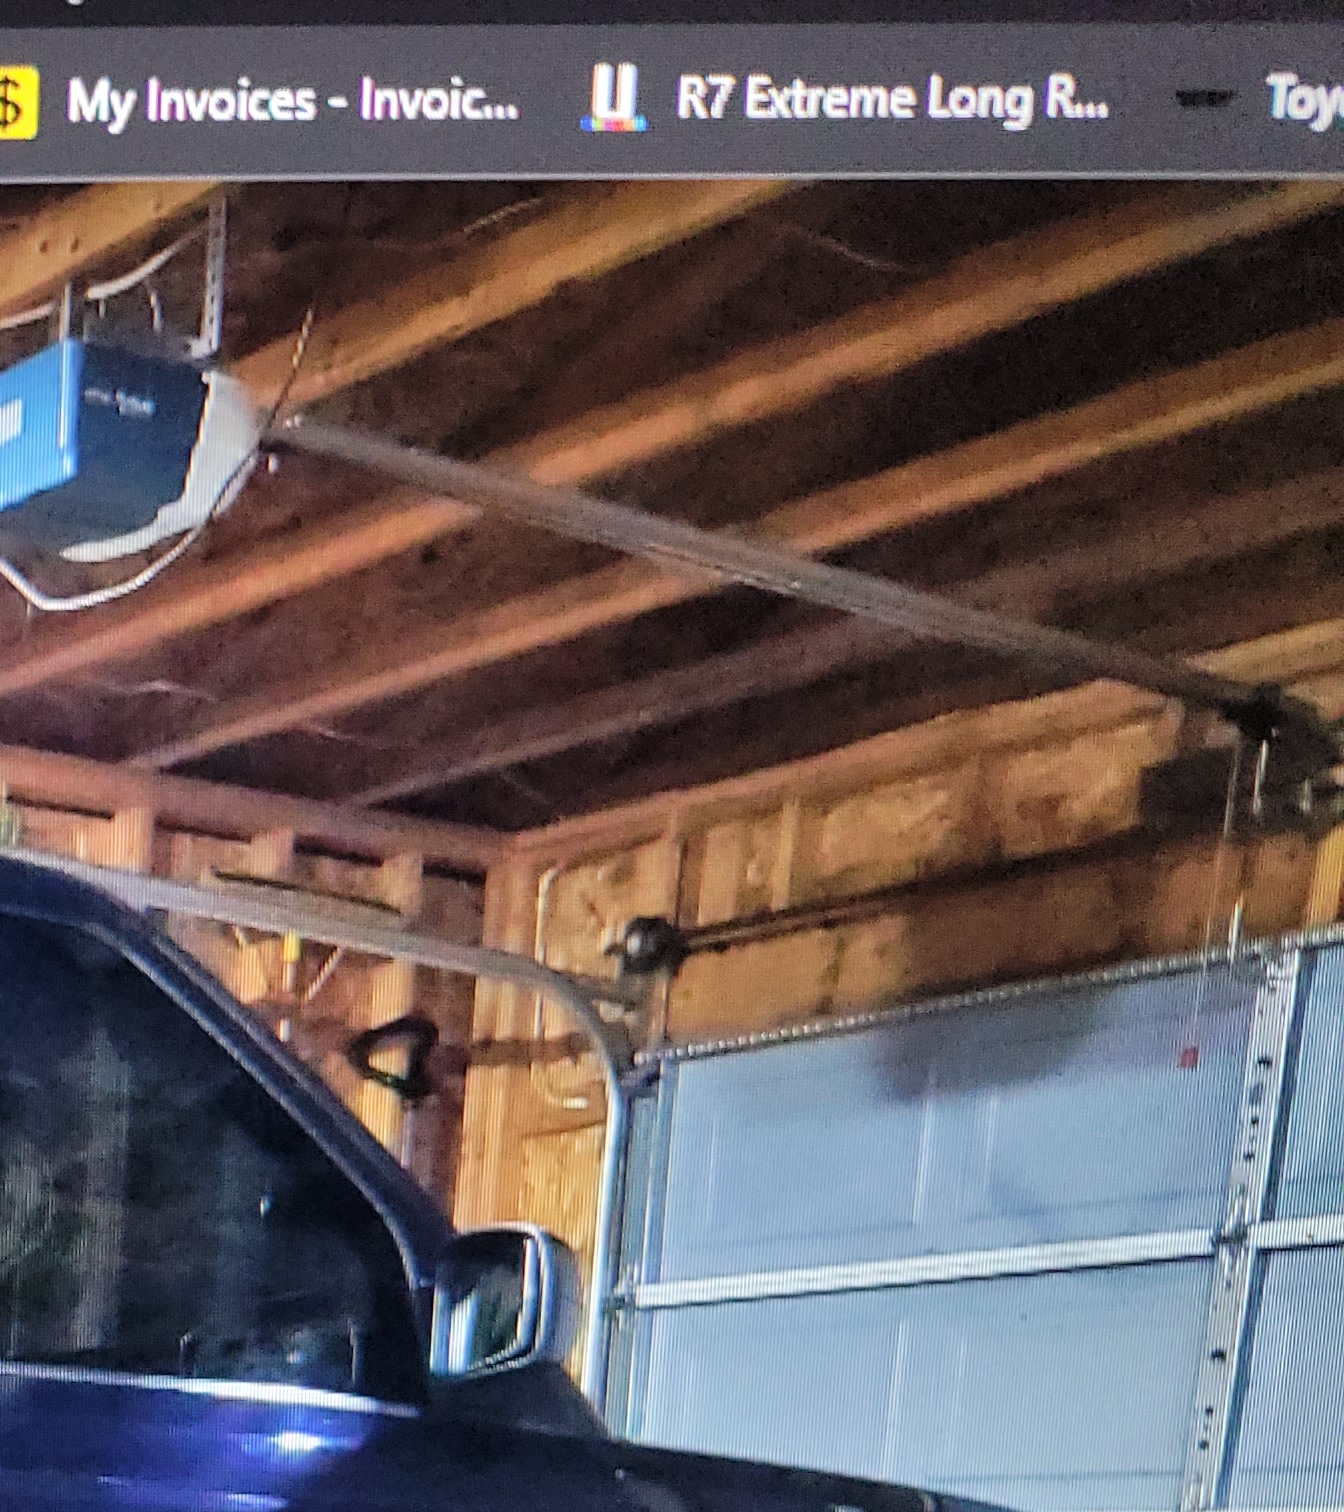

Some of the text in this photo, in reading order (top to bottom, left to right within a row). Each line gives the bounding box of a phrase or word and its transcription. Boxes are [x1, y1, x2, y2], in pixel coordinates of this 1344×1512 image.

[67, 75, 519, 135] My Invoices - Invoic...
[677, 72, 1109, 132] R7 Extreme Long R...
